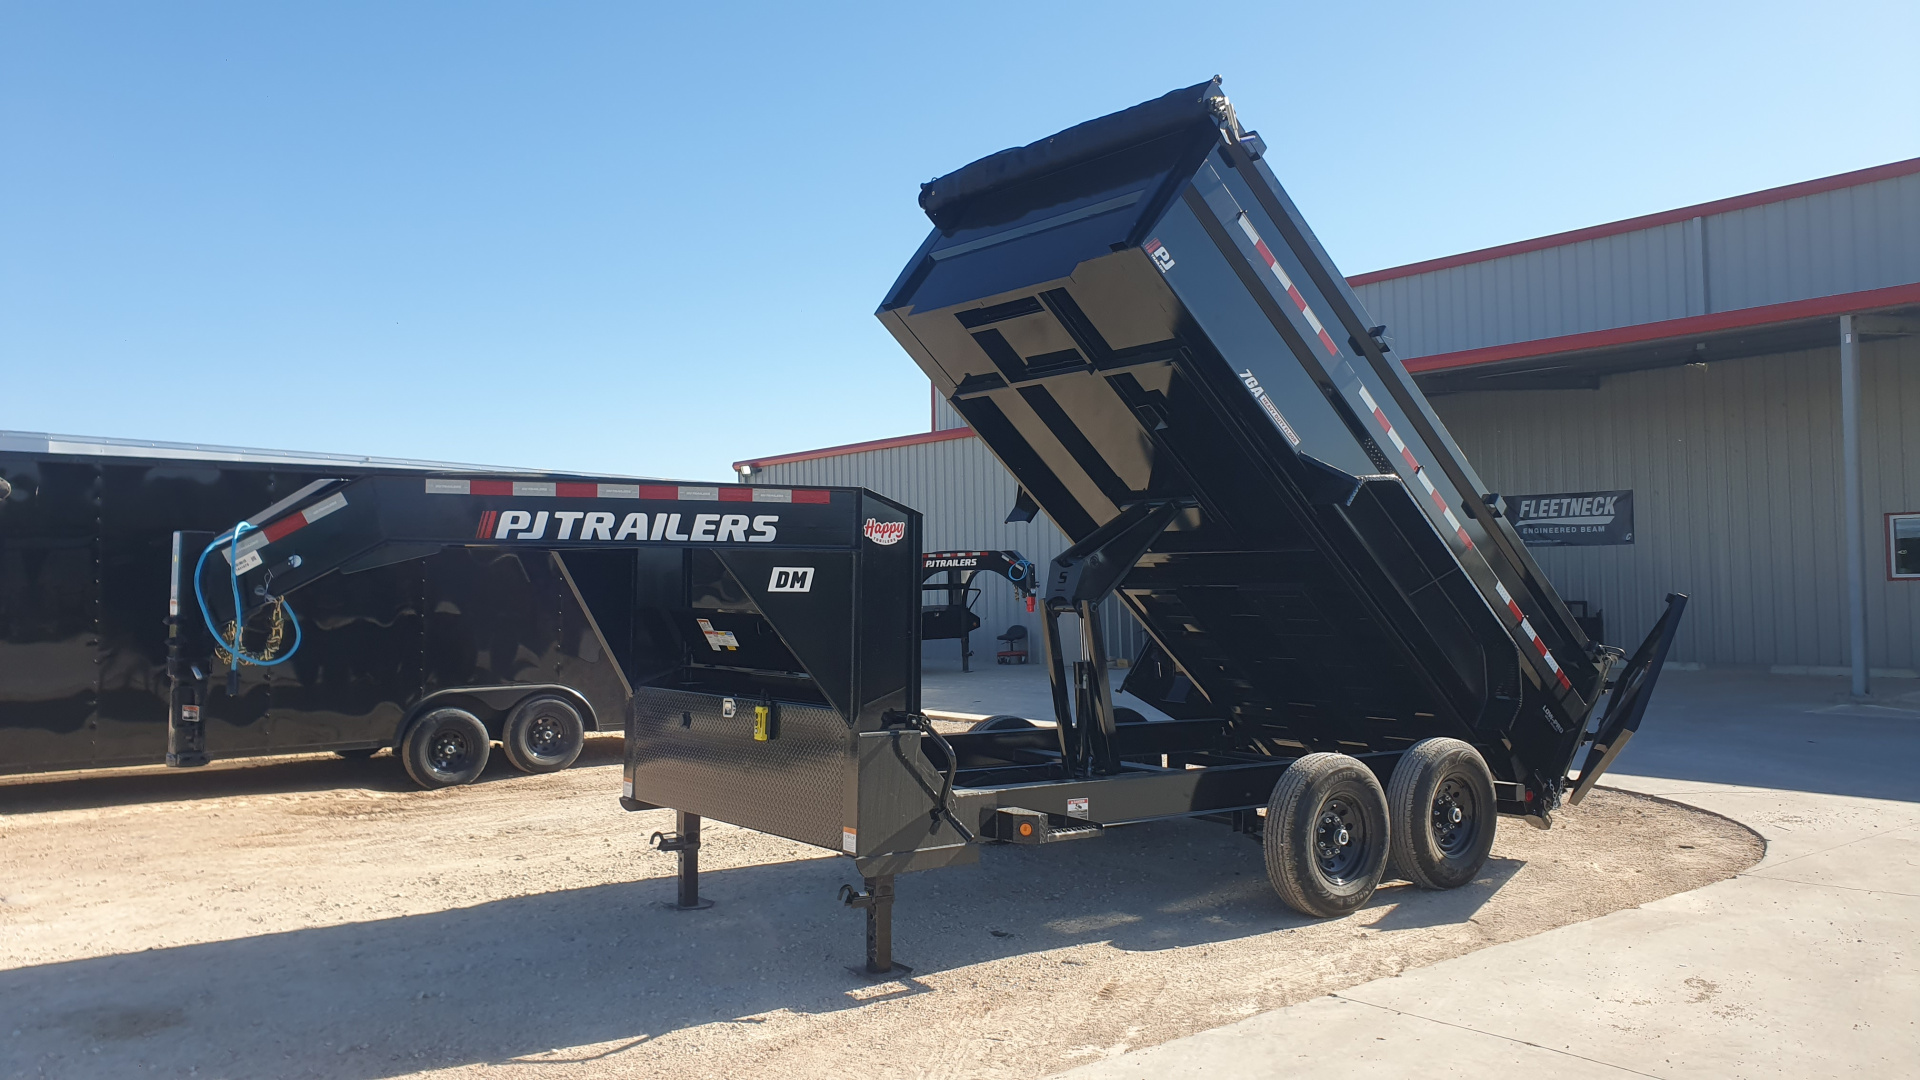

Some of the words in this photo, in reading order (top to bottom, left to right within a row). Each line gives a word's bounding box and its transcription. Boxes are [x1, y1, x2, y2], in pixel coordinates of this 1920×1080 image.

[1153, 246, 1176, 271] PJ
[1239, 368, 1264, 398] 7GA
[1262, 398, 1276, 414] HEAVY
[1274, 414, 1286, 427] DUTY
[1519, 496, 1618, 518] FLEETNECK
[495, 510, 549, 540] PJ
[553, 511, 779, 543] TRAILERS
[865, 519, 904, 539] Happy
[1522, 526, 1577, 534] ENGINEERED
[925, 560, 935, 568] PJ
[935, 558, 978, 568] TRAILERS
[775, 570, 808, 590] DM
